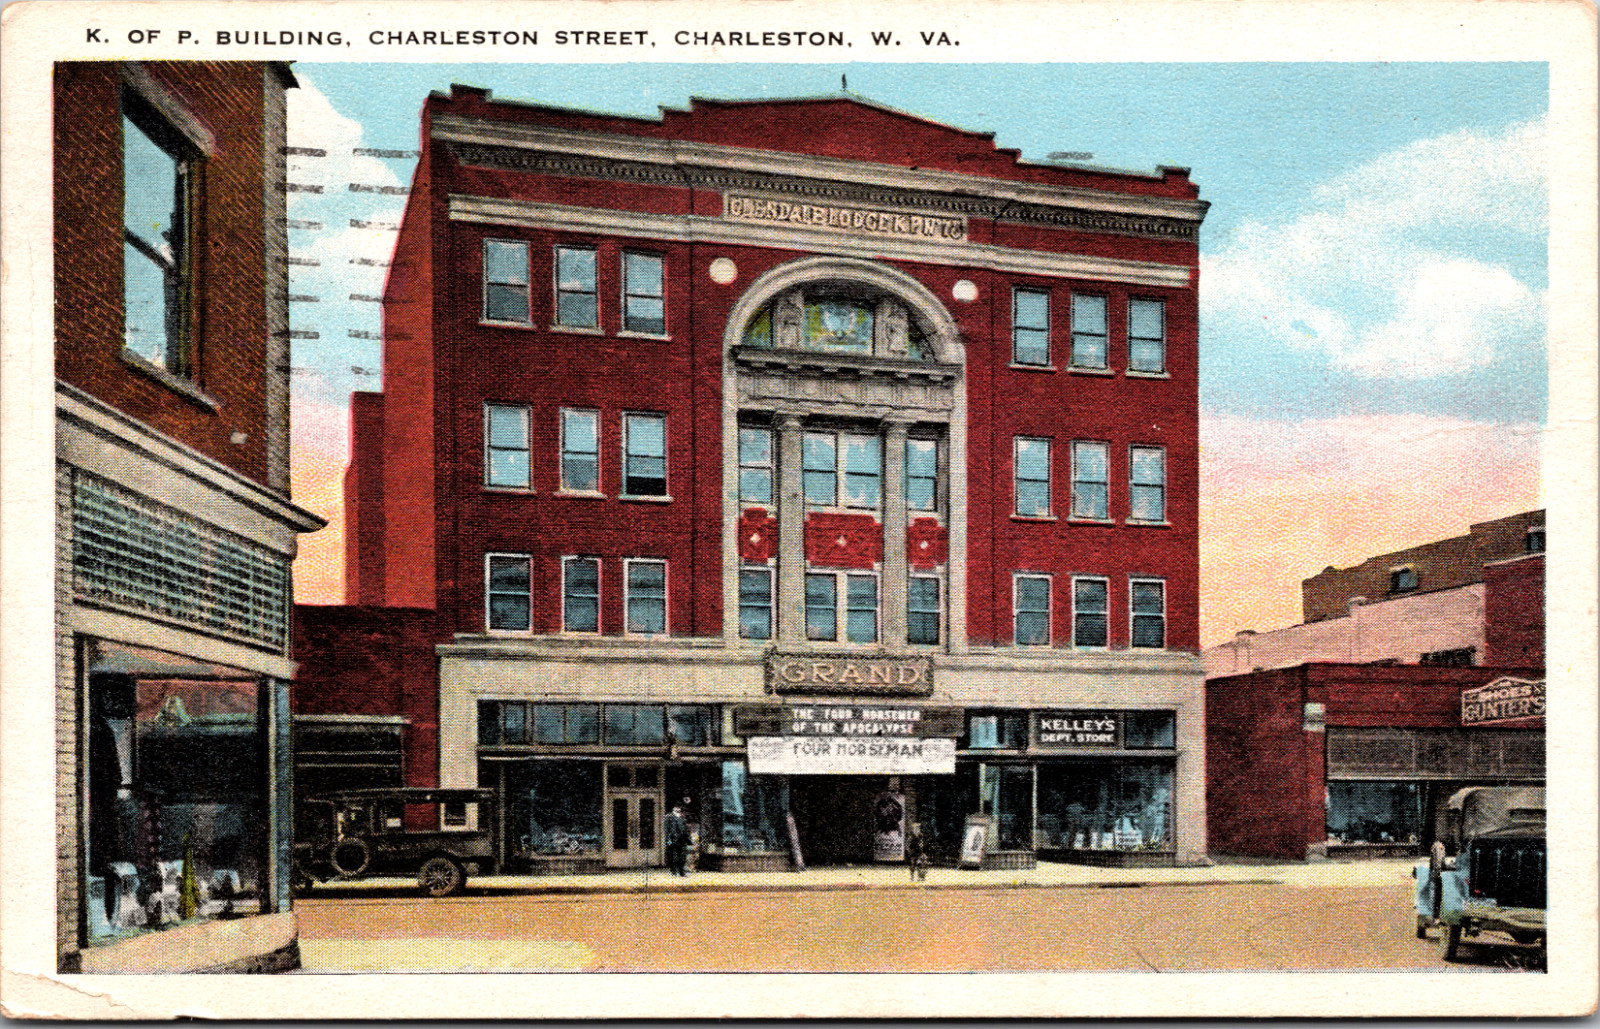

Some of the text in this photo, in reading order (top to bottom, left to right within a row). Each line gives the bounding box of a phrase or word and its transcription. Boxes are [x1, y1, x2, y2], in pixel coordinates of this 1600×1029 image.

[781, 663, 920, 684] GRAND
[792, 709, 813, 719] THE
[824, 709, 853, 720] FOUR
[792, 722, 913, 734] OF THE APOCALYPSE
[1040, 715, 1115, 731] KELLEY'S
[1040, 733, 1114, 742] DEPT. STORE
[793, 742, 831, 755] FOUR
[836, 743, 923, 756] HORSEMAN
